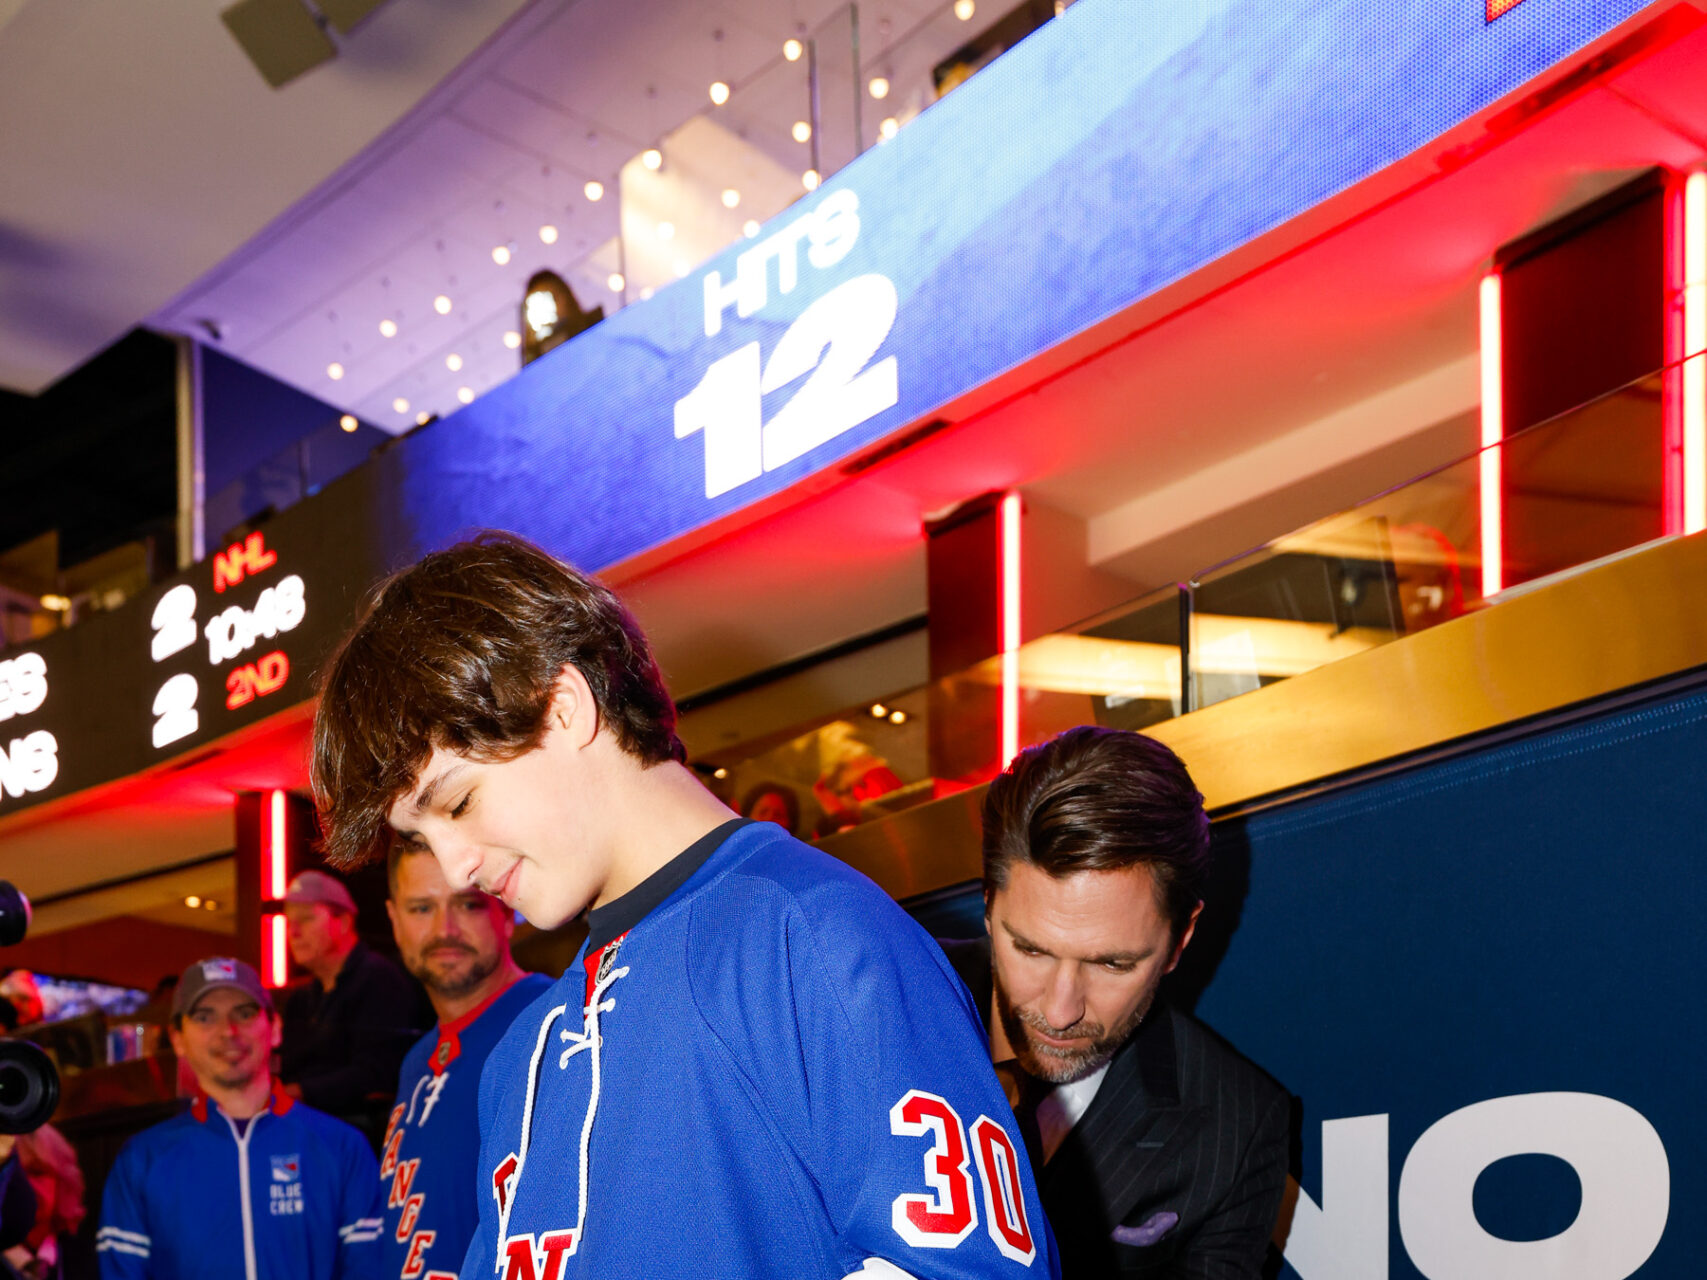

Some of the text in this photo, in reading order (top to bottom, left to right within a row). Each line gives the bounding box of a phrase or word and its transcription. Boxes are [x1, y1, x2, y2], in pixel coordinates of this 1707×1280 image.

[704, 188, 861, 337] HITS
[674, 273, 898, 499] 12
[213, 530, 278, 593] NHL
[151, 584, 197, 662] 2
[152, 673, 199, 749] 2
[226, 650, 290, 710] 2ND
[889, 1089, 1036, 1268] 30
